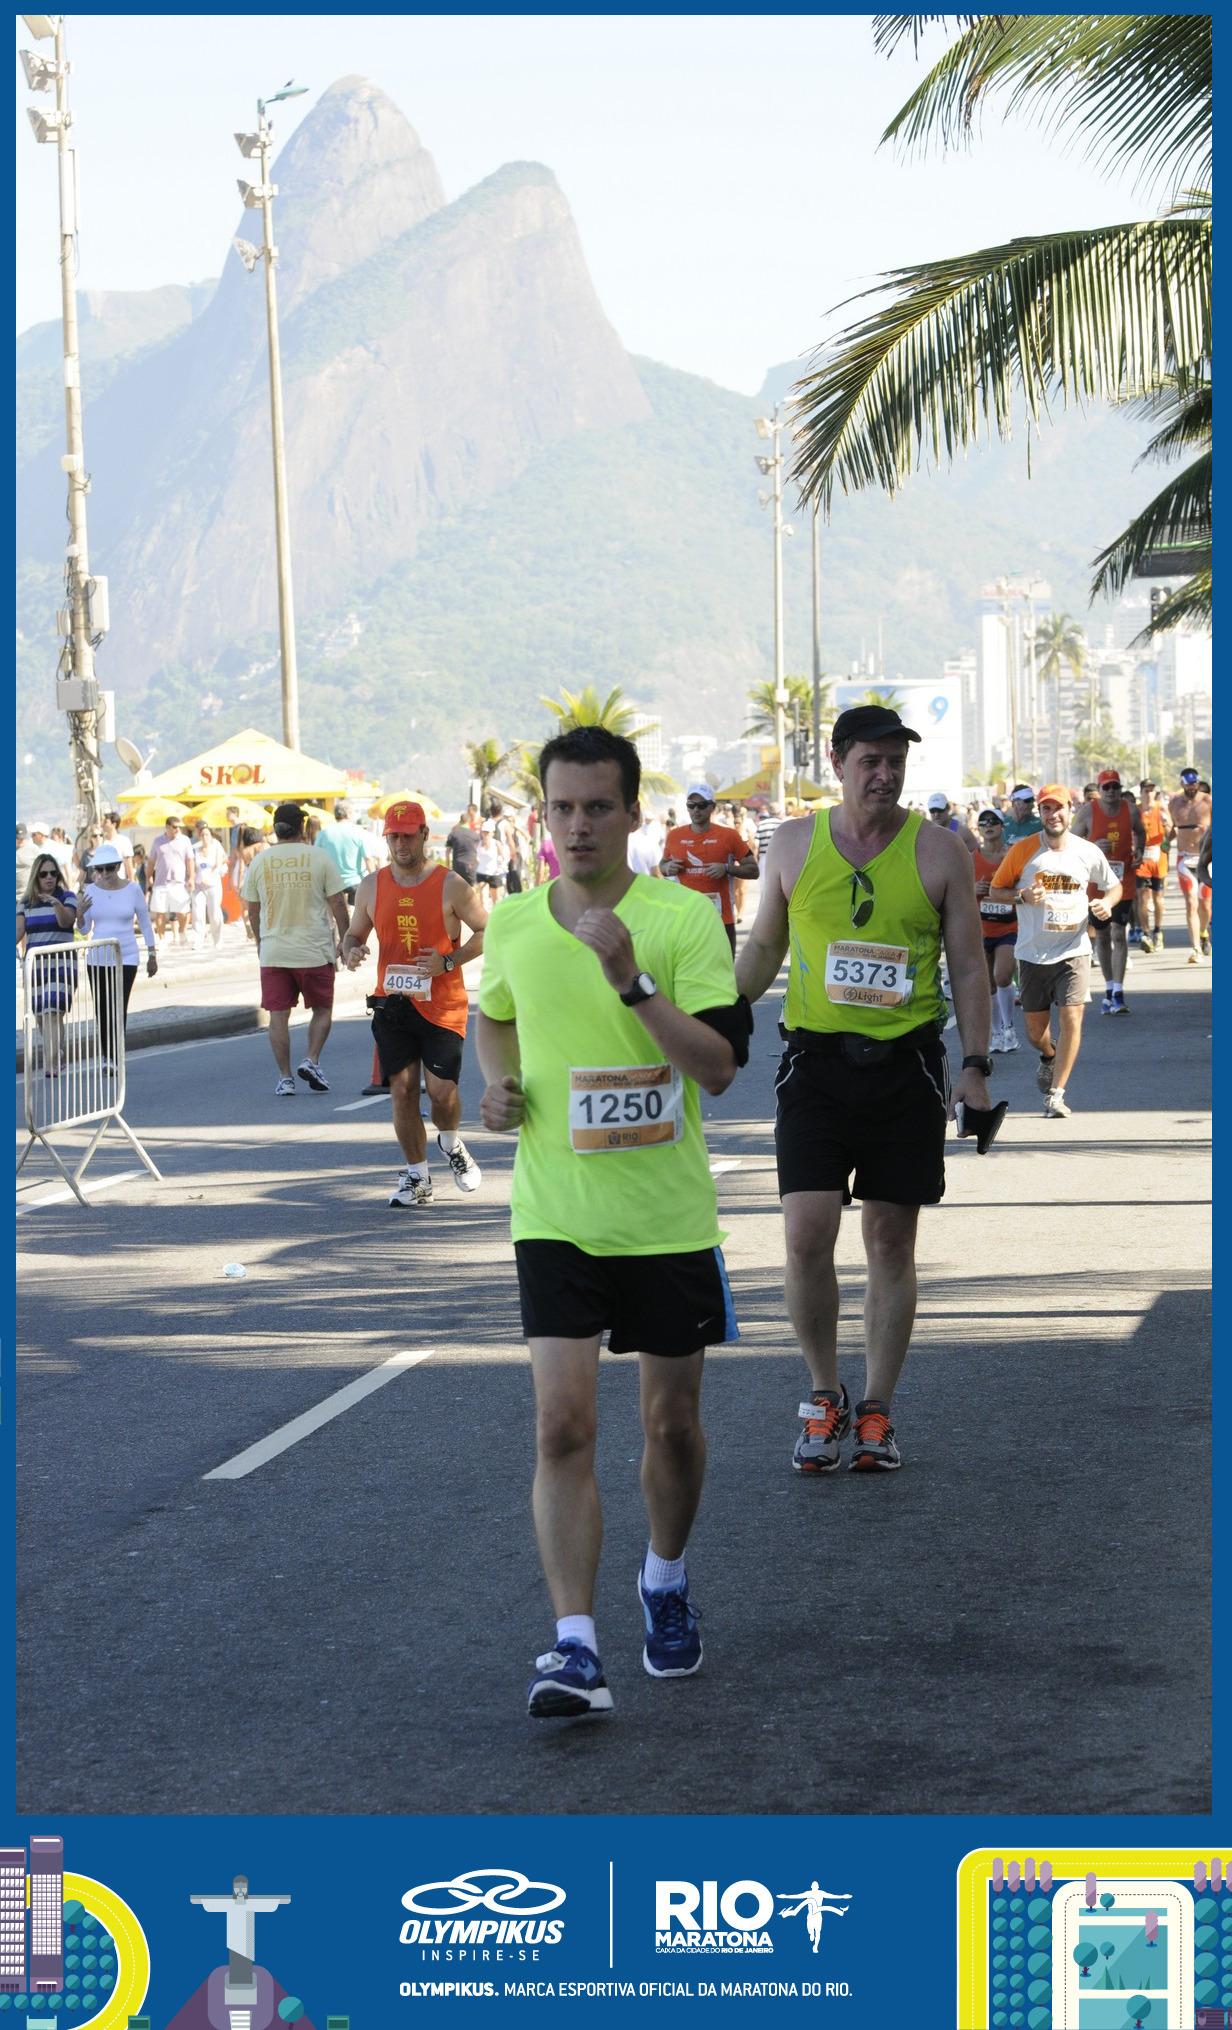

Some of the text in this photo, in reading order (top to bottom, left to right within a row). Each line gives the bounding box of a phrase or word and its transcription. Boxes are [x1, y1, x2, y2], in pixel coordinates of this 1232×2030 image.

[200, 763, 266, 785] SKOL
[270, 853, 312, 869] bali
[271, 881, 312, 889] samoa
[982, 903, 1007, 913] 2018
[397, 915, 418, 927] RIO
[834, 945, 876, 955] MARATONA
[833, 959, 897, 988] 5373
[386, 975, 422, 990] 4054
[858, 991, 883, 1004] Light
[575, 1074, 629, 1084] MARATONA
[579, 1090, 663, 1124] 1250
[622, 1132, 639, 1141] RIO
